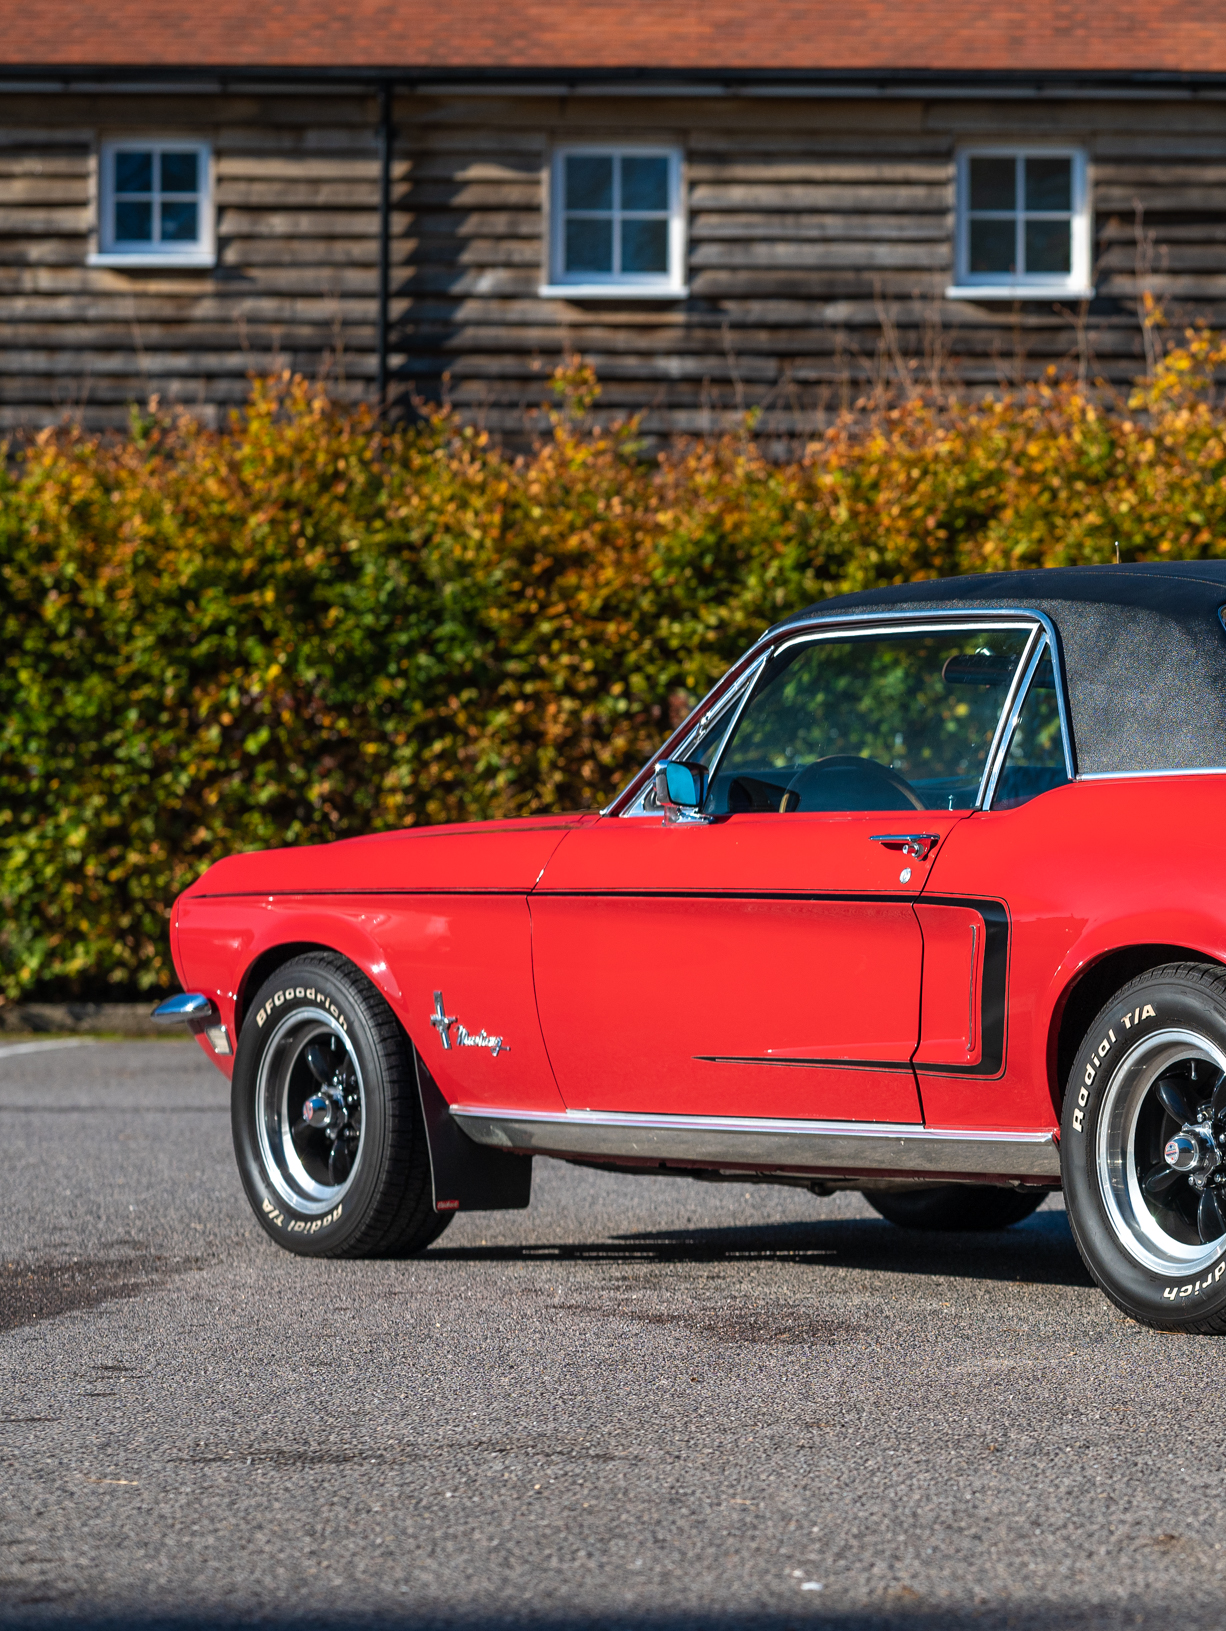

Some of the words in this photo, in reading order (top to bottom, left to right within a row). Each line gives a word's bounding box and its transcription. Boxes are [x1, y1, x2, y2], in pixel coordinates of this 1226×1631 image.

[256, 986, 348, 1031] BFGoodrich
[454, 1024, 509, 1057] Mustang
[1072, 1028, 1118, 1133] Radial
[1121, 1003, 1157, 1028] T/A
[262, 1198, 285, 1227] T/A
[287, 1204, 343, 1236] Radial
